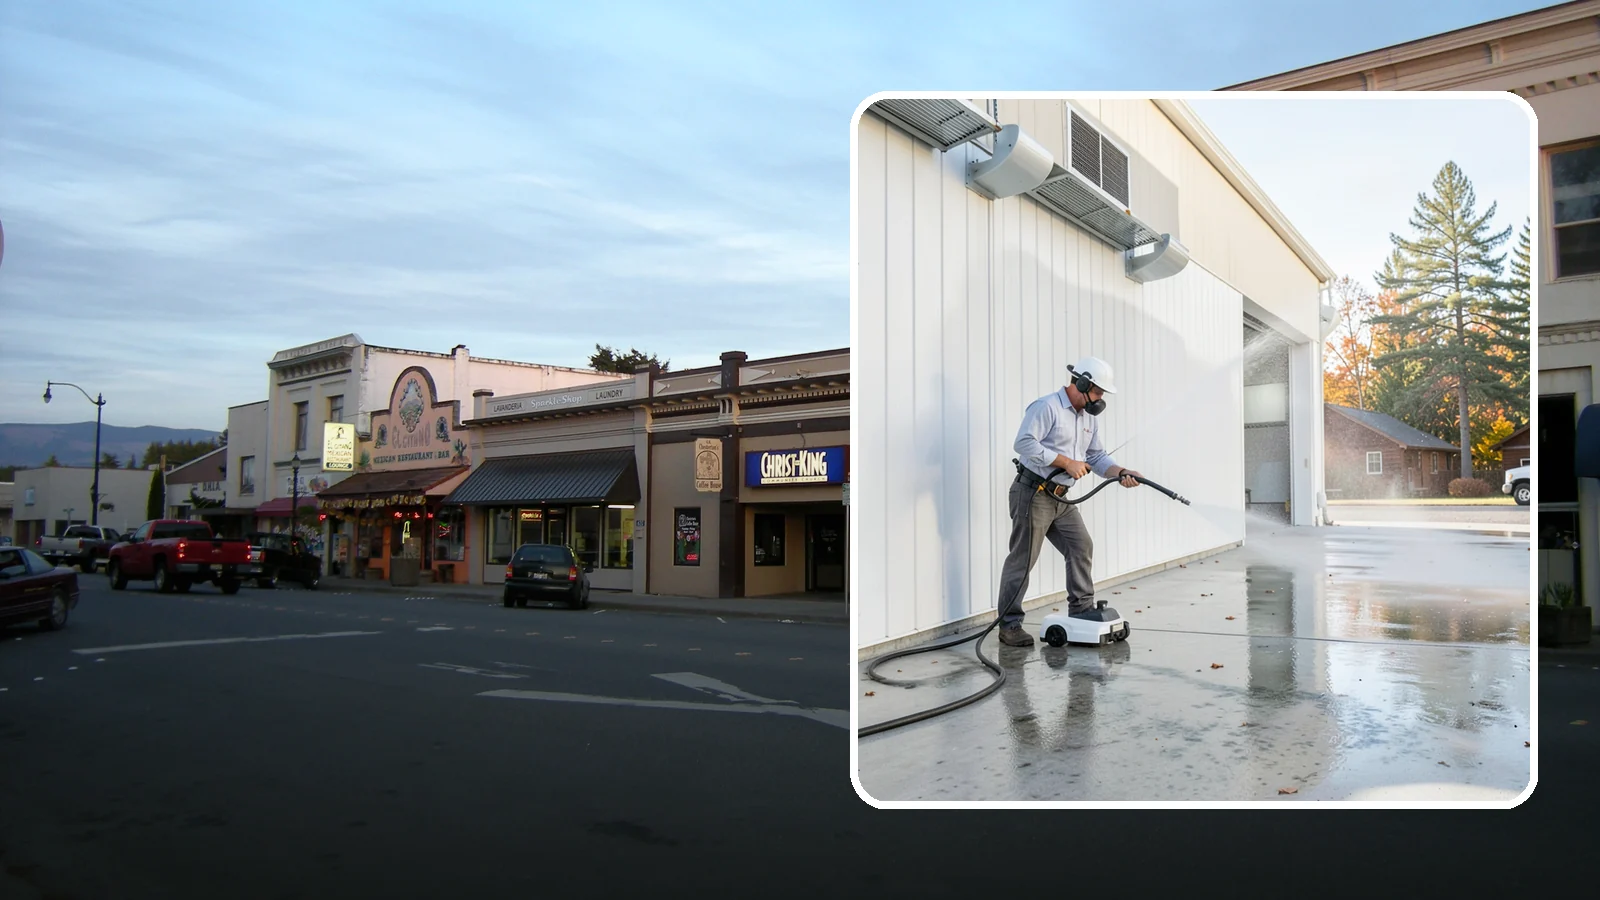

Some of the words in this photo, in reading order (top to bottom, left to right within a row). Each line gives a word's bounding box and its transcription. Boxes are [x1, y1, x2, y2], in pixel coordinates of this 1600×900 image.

[562, 394, 582, 404] Shop
[595, 389, 623, 400] LAUNDRY
[493, 402, 522, 412] LAVANDERIA
[373, 455, 396, 464] MEXICAN
[398, 452, 433, 462] RESTAURANT
[438, 450, 450, 459] BAR
[761, 452, 797, 477] CHRIST
[799, 450, 827, 476] KING
